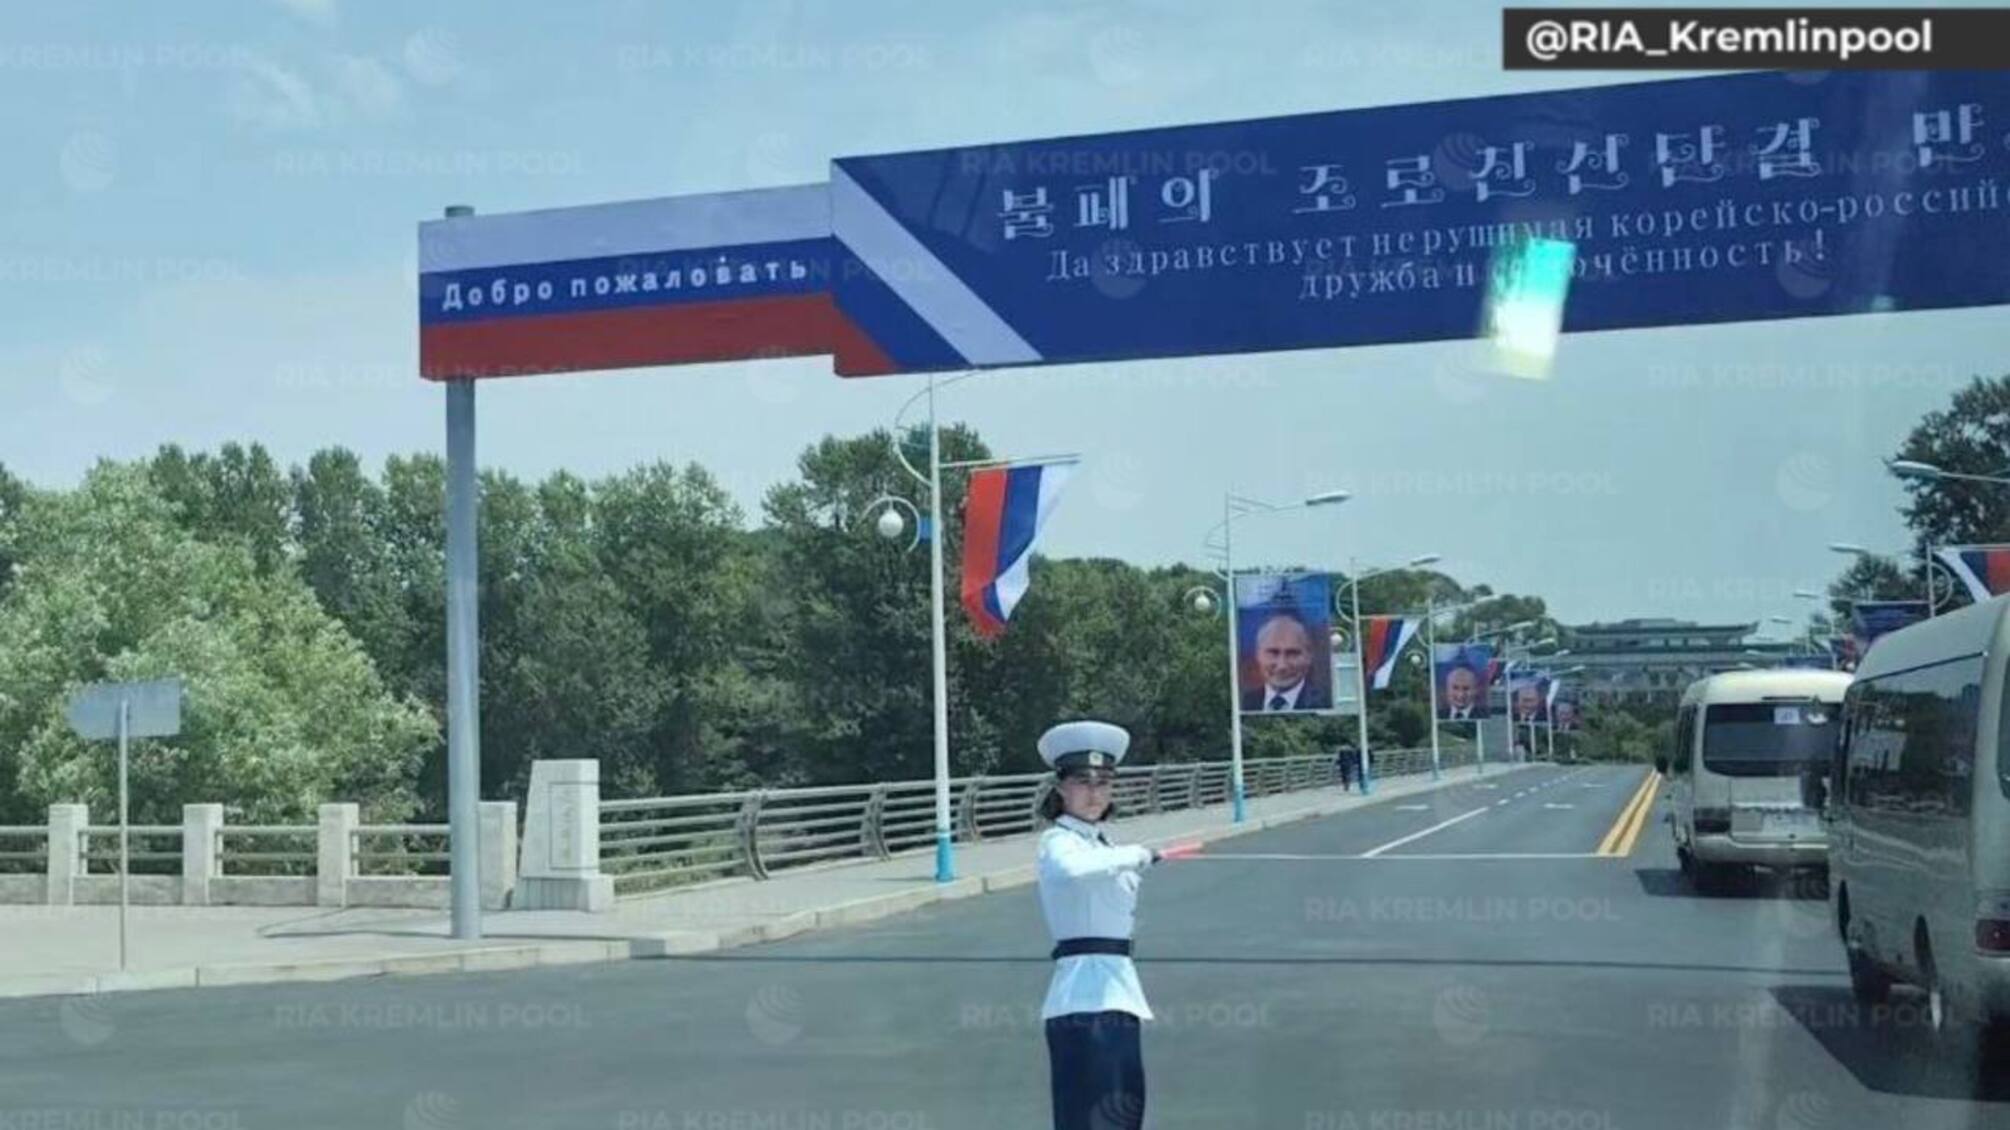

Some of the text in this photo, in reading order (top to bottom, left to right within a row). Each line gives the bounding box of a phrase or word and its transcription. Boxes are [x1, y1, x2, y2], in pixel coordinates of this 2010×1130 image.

[998, 168, 1221, 240] 불패의
[1046, 250, 1090, 282] Да
[1105, 235, 1356, 275] здравствует
[1611, 178, 2010, 237] корейско-россий
[442, 278, 553, 311] Добро
[571, 259, 807, 297] пожаловать
[1298, 262, 1440, 299] дружба
[1456, 264, 1474, 287] и
